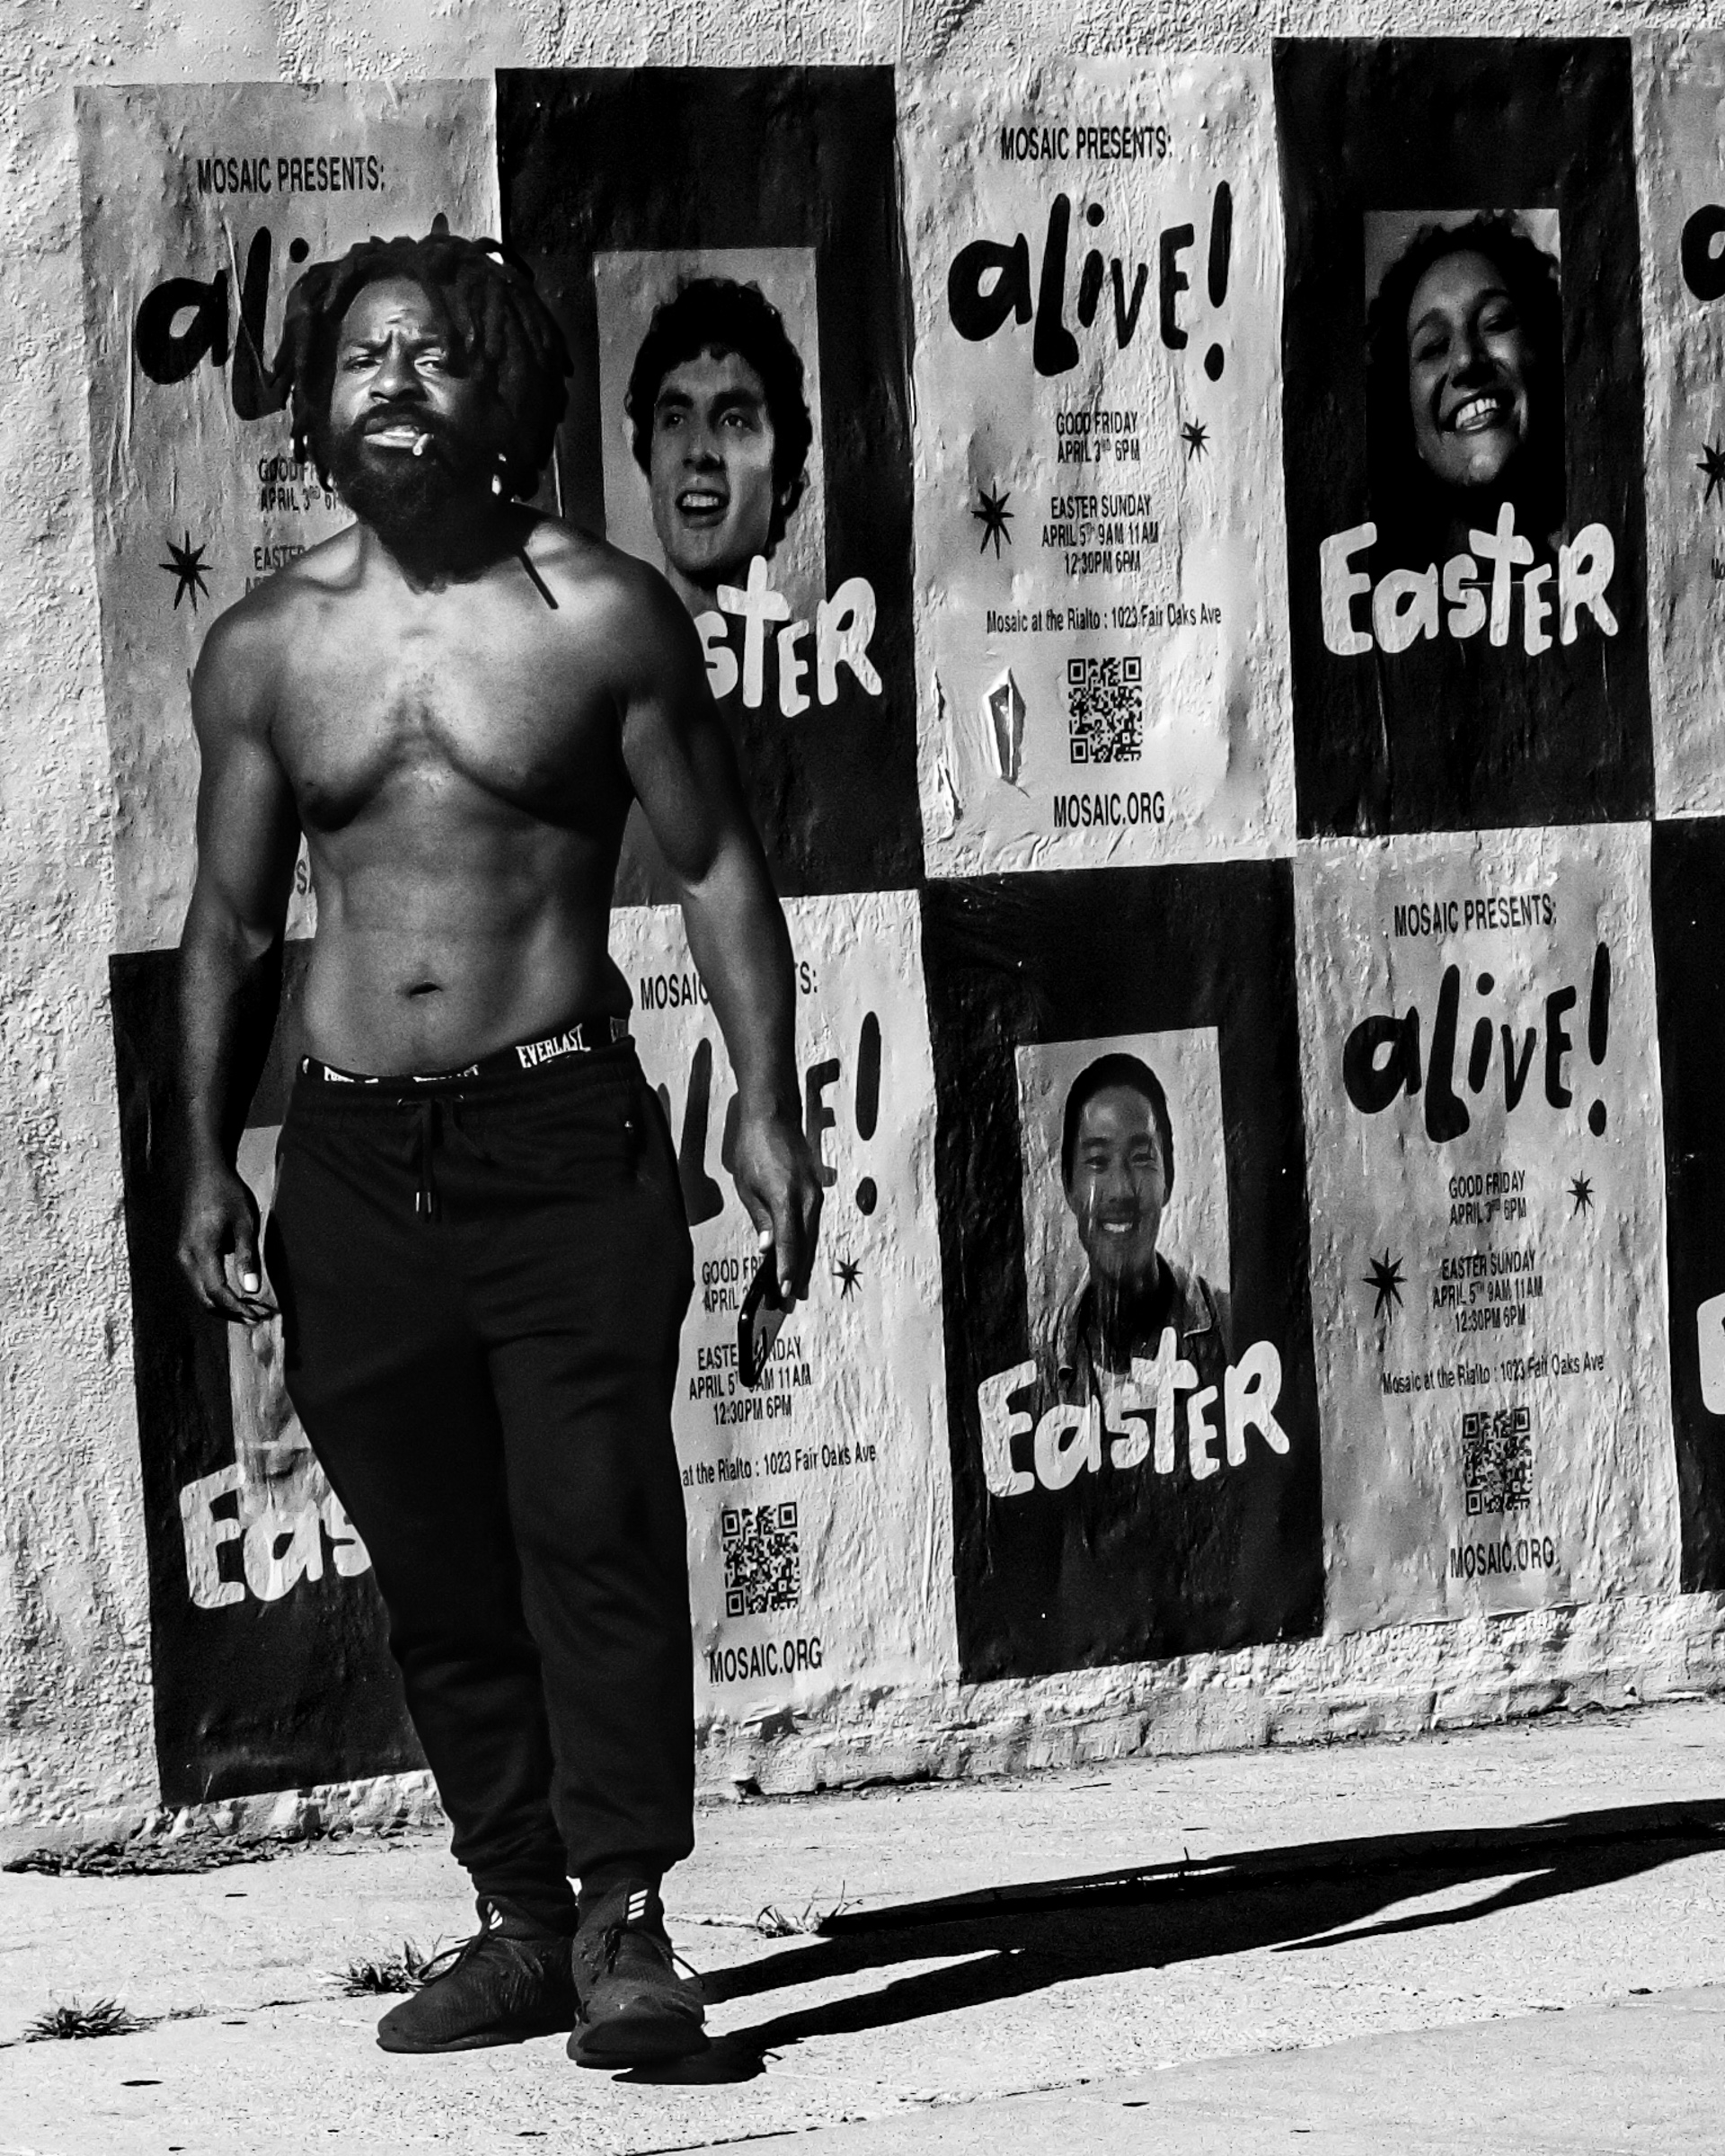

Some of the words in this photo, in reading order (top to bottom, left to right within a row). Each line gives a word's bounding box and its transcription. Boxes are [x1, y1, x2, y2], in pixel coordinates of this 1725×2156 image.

[1001, 128, 1070, 160] MOSAIC
[1077, 126, 1172, 159] PRESENTS:
[198, 158, 270, 193] MOSAIC
[278, 155, 385, 191] PRESENTS:
[1057, 411, 1092, 436] GOOD
[1095, 411, 1138, 434] FRIDAY
[1058, 438, 1092, 463] APRIL
[1115, 438, 1140, 461] 6PM
[261, 487, 300, 511] APRIL
[1051, 496, 1097, 519] EASTER
[1101, 495, 1153, 518] SUNDAY
[1041, 523, 1076, 547] APRIL
[1098, 523, 1124, 545] 9AM
[1128, 521, 1159, 543] 11AM
[1065, 551, 1112, 575] 12:30PM
[1115, 551, 1140, 574] 6PM
[986, 610, 1028, 633] Mosaic
[1031, 611, 1042, 632] at
[1046, 609, 1064, 631] the
[1067, 607, 1101, 630] Rialto
[1111, 606, 1138, 629] 1023
[1141, 605, 1163, 627] Fair
[1168, 603, 1197, 626] Oaks
[1200, 602, 1222, 624] Ave
[1054, 791, 1164, 827] MOSAIC.ORG
[1393, 901, 1458, 937] MOSAIC
[1464, 894, 1557, 933] PRESENTS:
[516, 1023, 591, 1069] EVERLAST
[1449, 1175, 1482, 1199] GOOD
[1486, 1170, 1526, 1195] FRIDAY
[1449, 1202, 1482, 1226] APRIL
[1504, 1197, 1526, 1220] 6PM
[703, 1259, 739, 1285] GOOD
[1442, 1255, 1486, 1280] EASTER
[1491, 1250, 1535, 1276] SUNDAY
[703, 1287, 739, 1312] APRIL
[1433, 1283, 1466, 1309] APRIL
[1516, 1276, 1543, 1299] 11AM
[1455, 1308, 1500, 1332] 12:30PM
[1503, 1303, 1526, 1328] 6PM
[698, 1344, 739, 1370] EASTE
[690, 1374, 724, 1401] APRIL
[778, 1363, 811, 1389] 11AM
[1383, 1370, 1421, 1393] Mosaic
[1424, 1369, 1436, 1391] at
[1438, 1365, 1455, 1388] the
[1458, 1362, 1491, 1386] Rialto
[1500, 1358, 1526, 1382] 1023
[1552, 1354, 1579, 1376] Oaks
[1583, 1352, 1605, 1373] Ave
[713, 1398, 763, 1426] 12:30PM
[766, 1394, 792, 1418] 6PM
[683, 1464, 694, 1486] at
[697, 1462, 714, 1484] the
[719, 1456, 752, 1481] Rialto
[764, 1450, 792, 1475] 1023
[795, 1447, 818, 1471] Fair
[822, 1444, 852, 1467] Oaks
[855, 1442, 876, 1464] Ave
[1451, 1536, 1554, 1578] MOSAIC.ORG
[710, 1637, 823, 1684] MOSAIC.ORG
